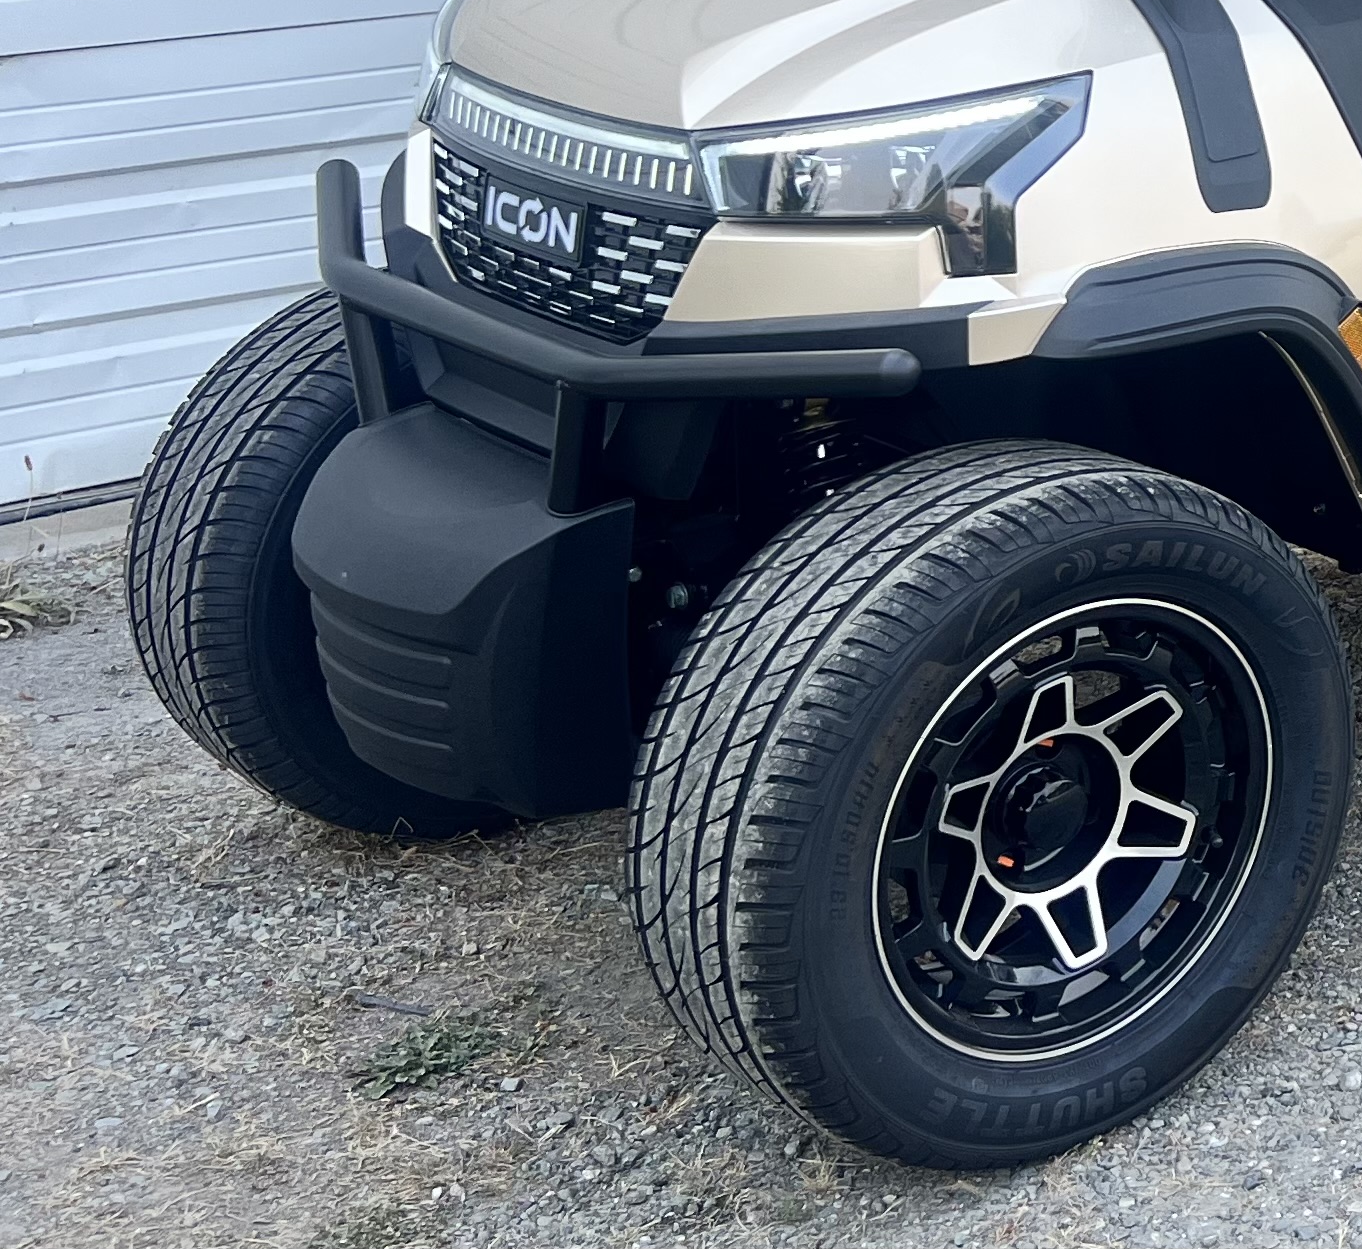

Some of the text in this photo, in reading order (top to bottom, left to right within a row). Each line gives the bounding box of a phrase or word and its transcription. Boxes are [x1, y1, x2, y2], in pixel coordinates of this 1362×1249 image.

[483, 186, 578, 254] ICON
[1102, 540, 1267, 596] SAILUN
[1292, 770, 1332, 887] OUTSIDE
[919, 1066, 1148, 1137] SHUTTLE
